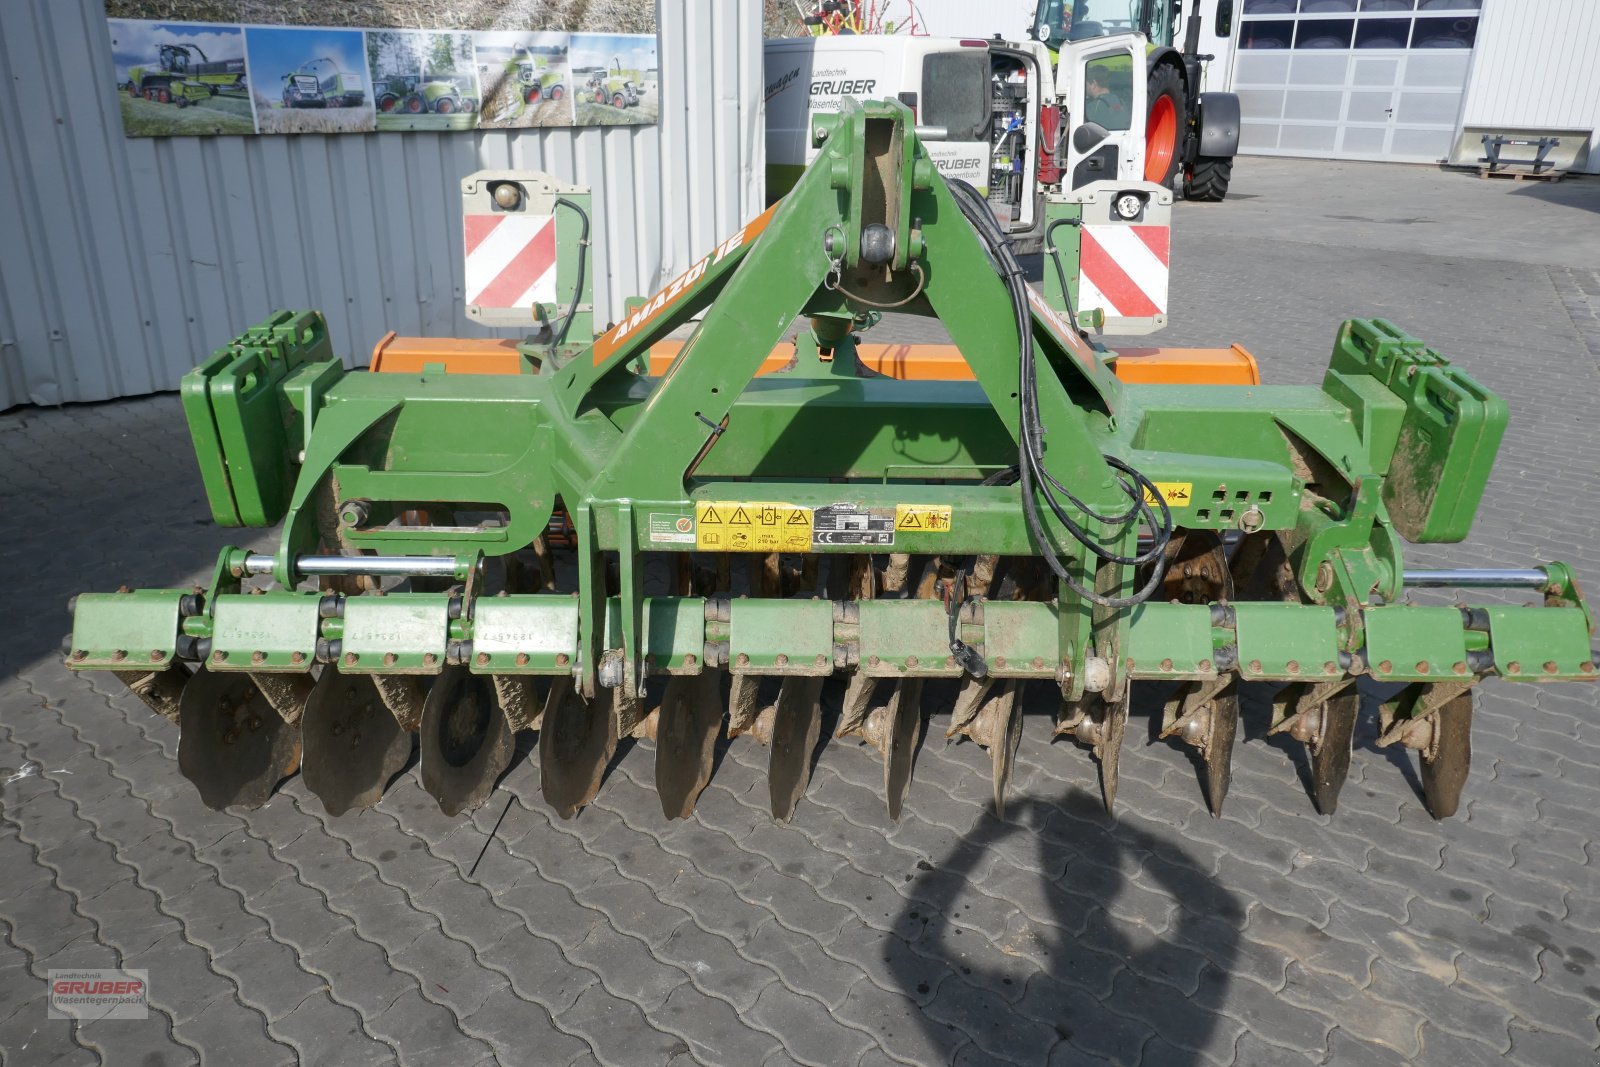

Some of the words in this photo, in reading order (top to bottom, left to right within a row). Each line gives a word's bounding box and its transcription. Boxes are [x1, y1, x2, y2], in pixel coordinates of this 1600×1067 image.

[811, 69, 847, 78] Landtechnik
[809, 80, 877, 96] GRUBER
[931, 150, 958, 158] andtechnik
